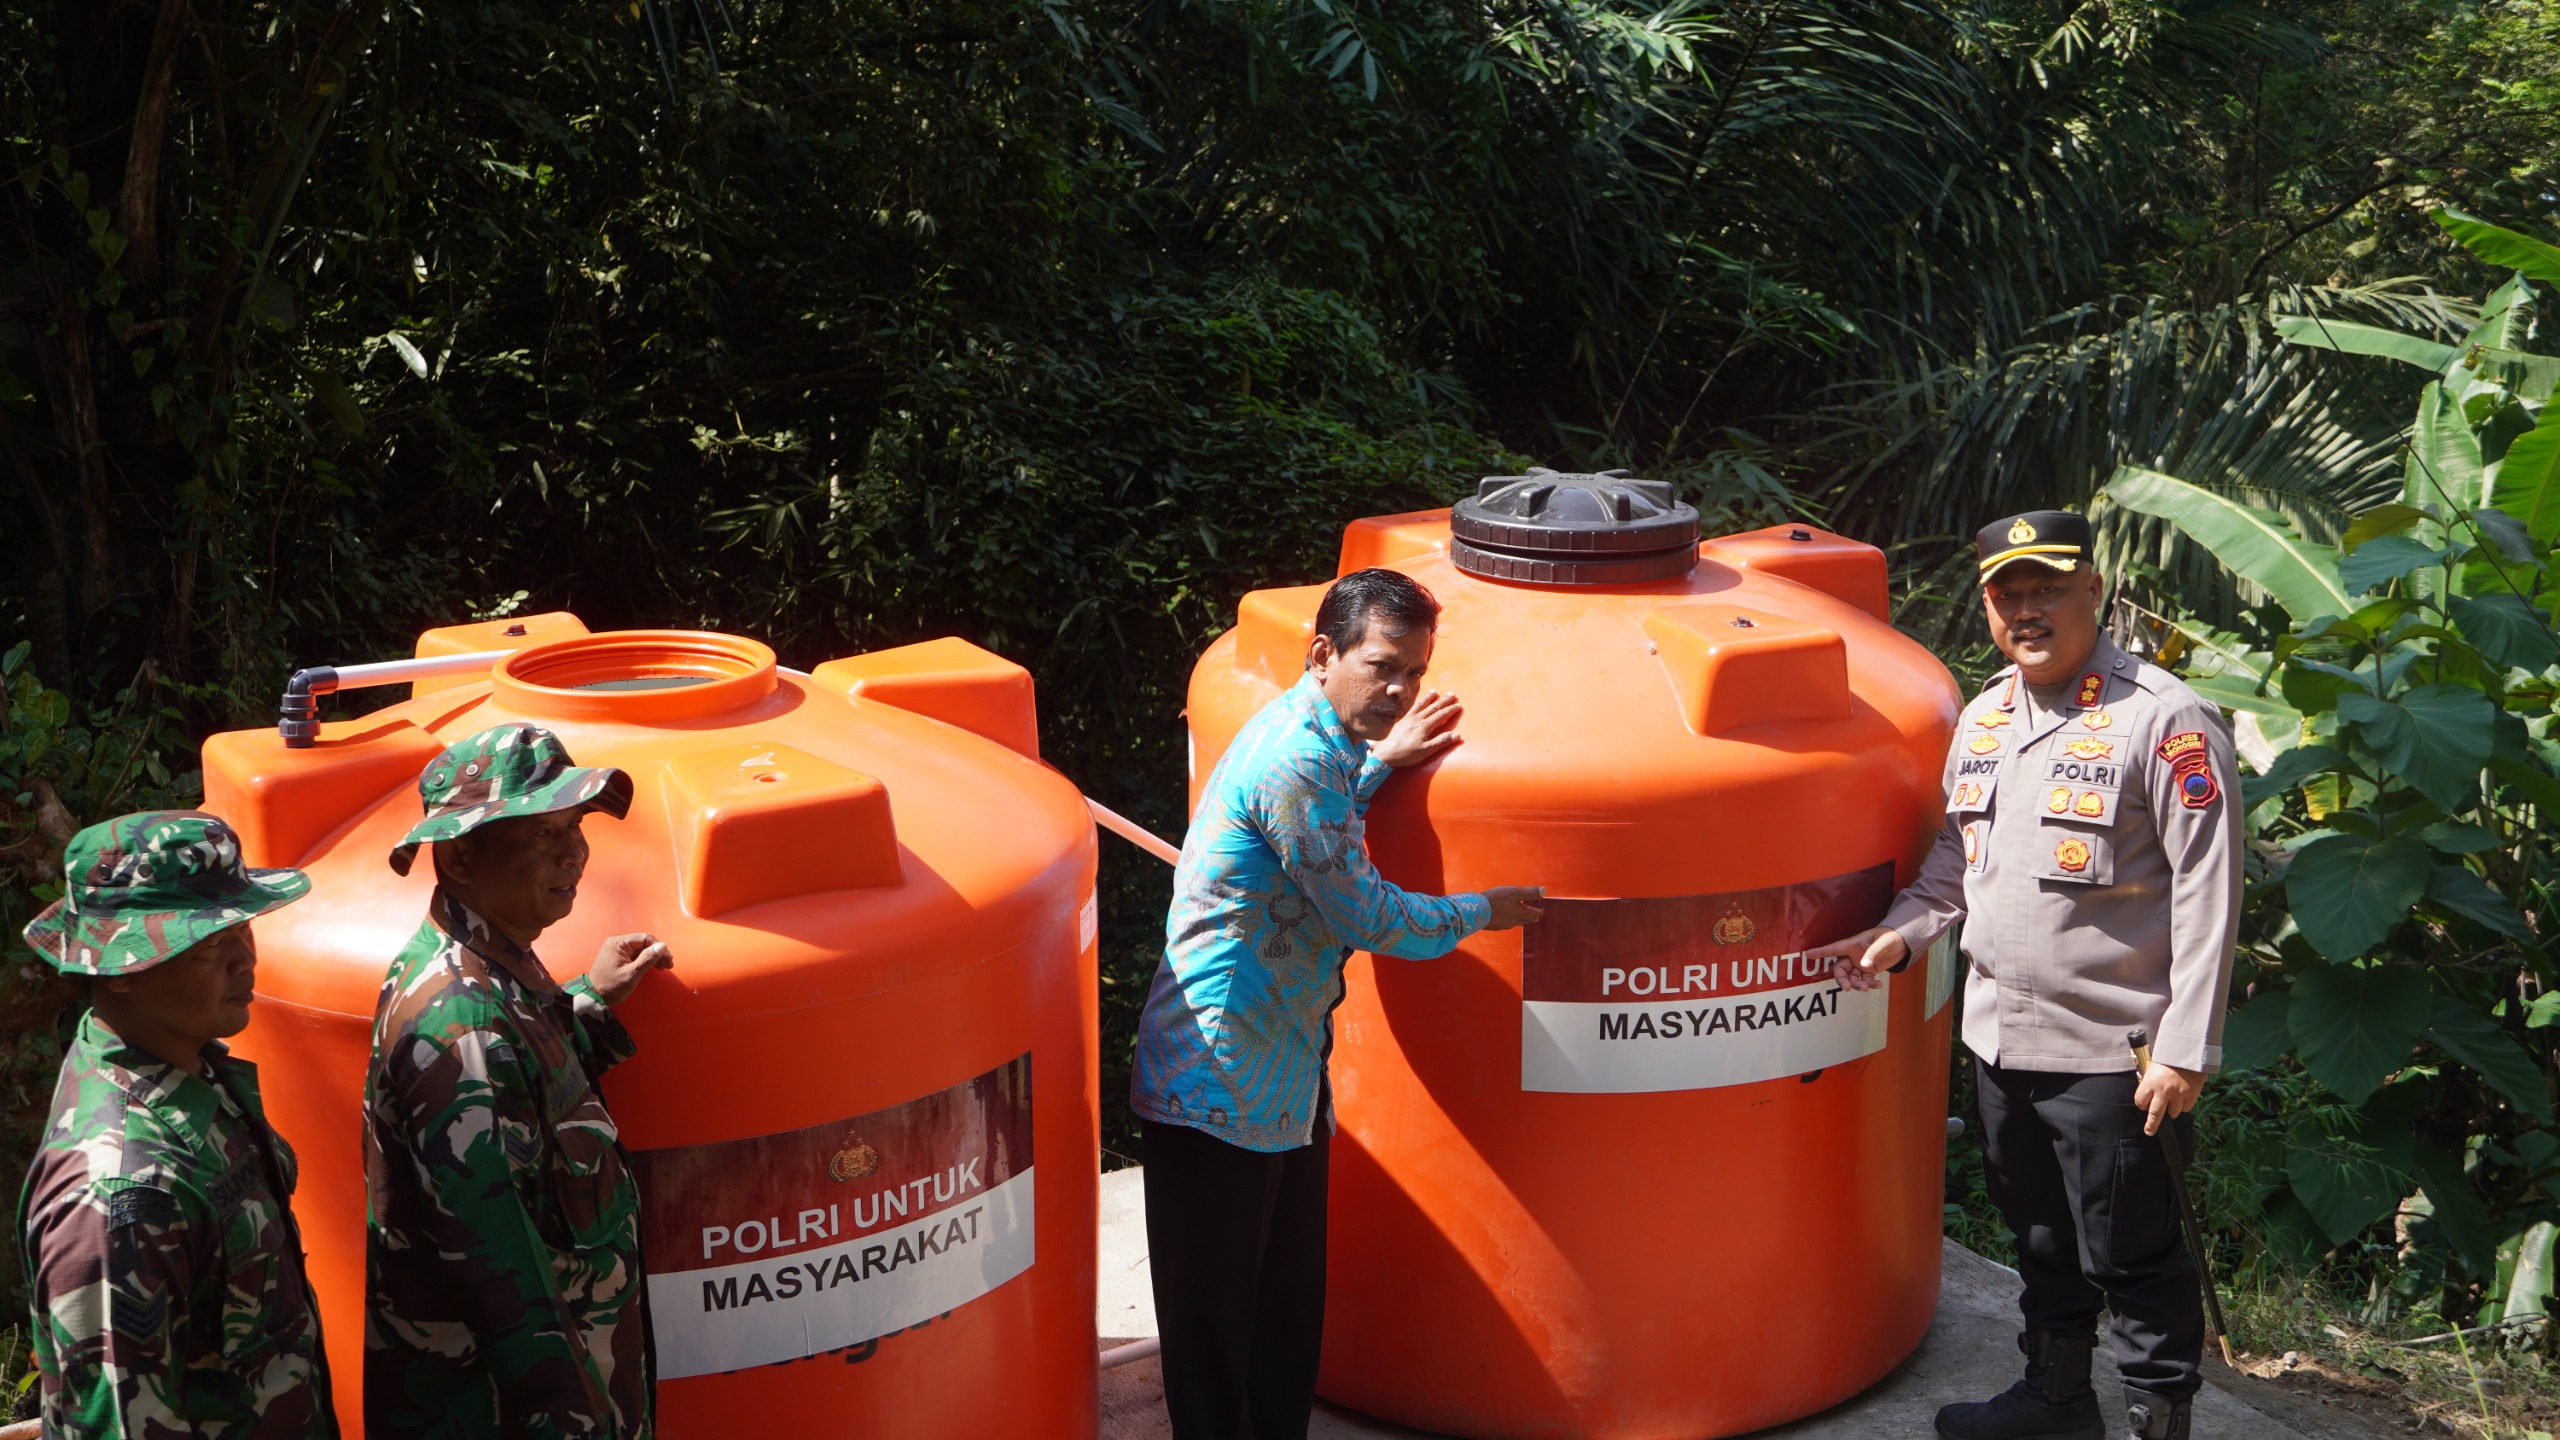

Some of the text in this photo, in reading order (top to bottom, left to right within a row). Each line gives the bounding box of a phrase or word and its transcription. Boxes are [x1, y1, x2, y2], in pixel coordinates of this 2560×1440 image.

[2164, 733, 2199, 751] POLRES
[1958, 759, 1999, 776] JAROT
[2051, 762, 2116, 786] POLRI
[1602, 963, 1718, 996] POLRI
[1599, 987, 1843, 1040] MASYARAKAT
[702, 1156, 981, 1260] POLRI UNTUK
[702, 1205, 983, 1313] MASYARAKAT
